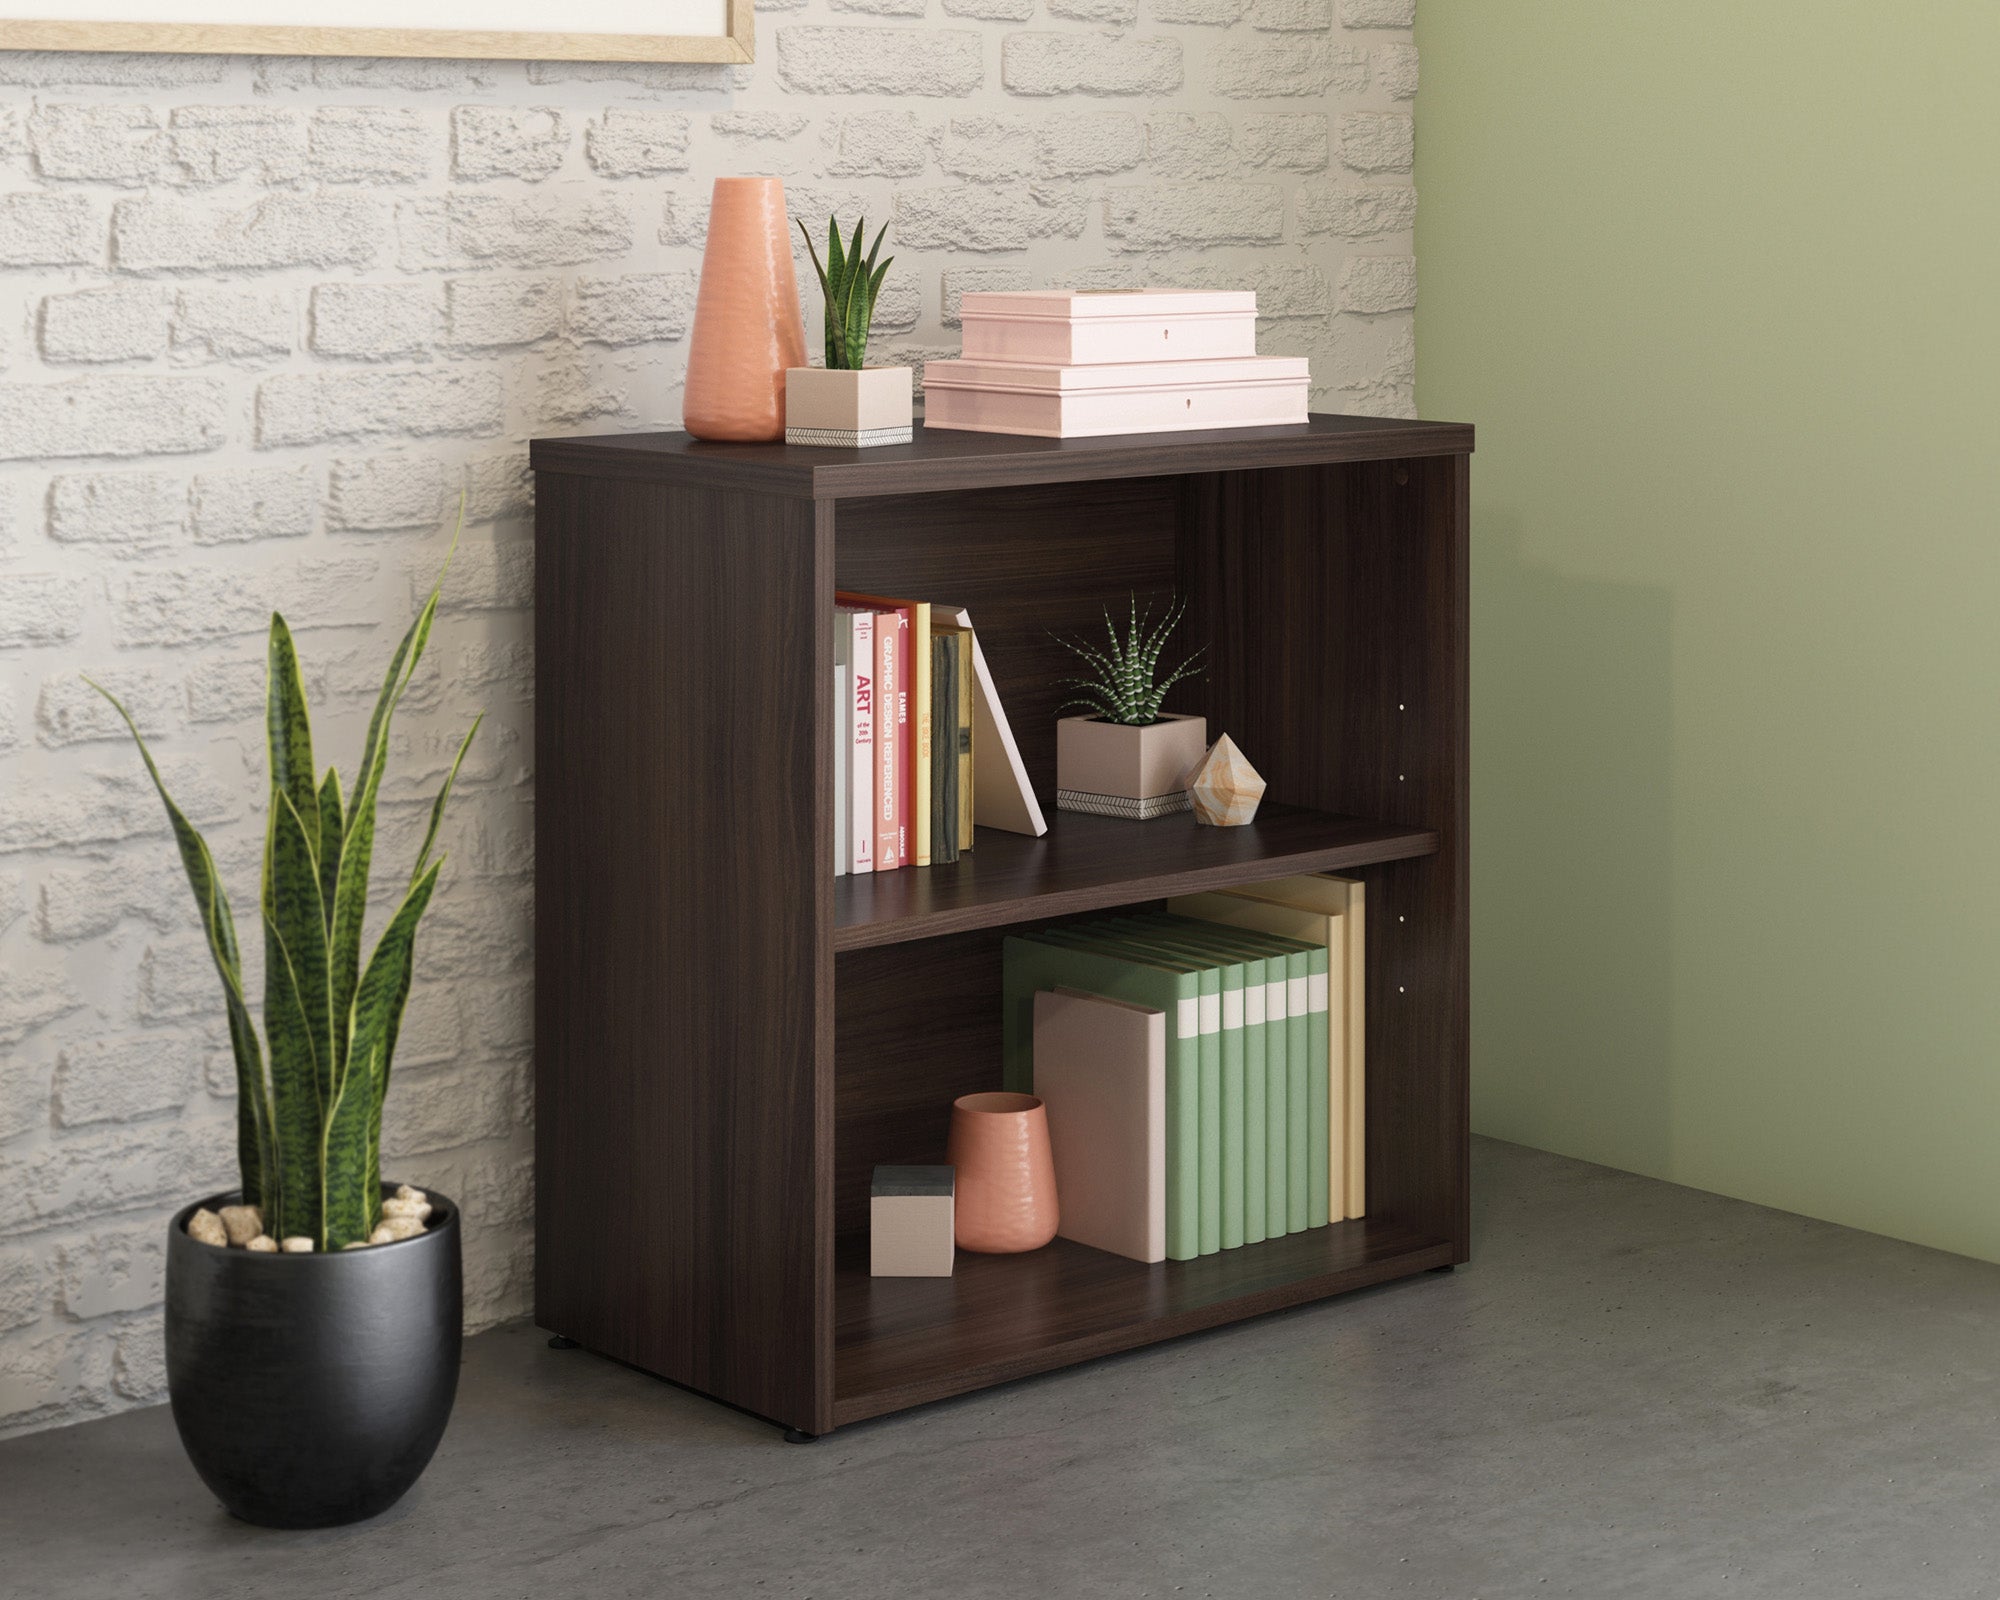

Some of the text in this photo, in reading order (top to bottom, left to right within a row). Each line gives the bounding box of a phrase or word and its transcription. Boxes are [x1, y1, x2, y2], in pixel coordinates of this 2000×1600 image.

[883, 636, 893, 690] GRAPHIC
[857, 675, 871, 714] ART
[883, 693, 893, 738] DESIGN
[883, 741, 893, 820] REFERENCED
